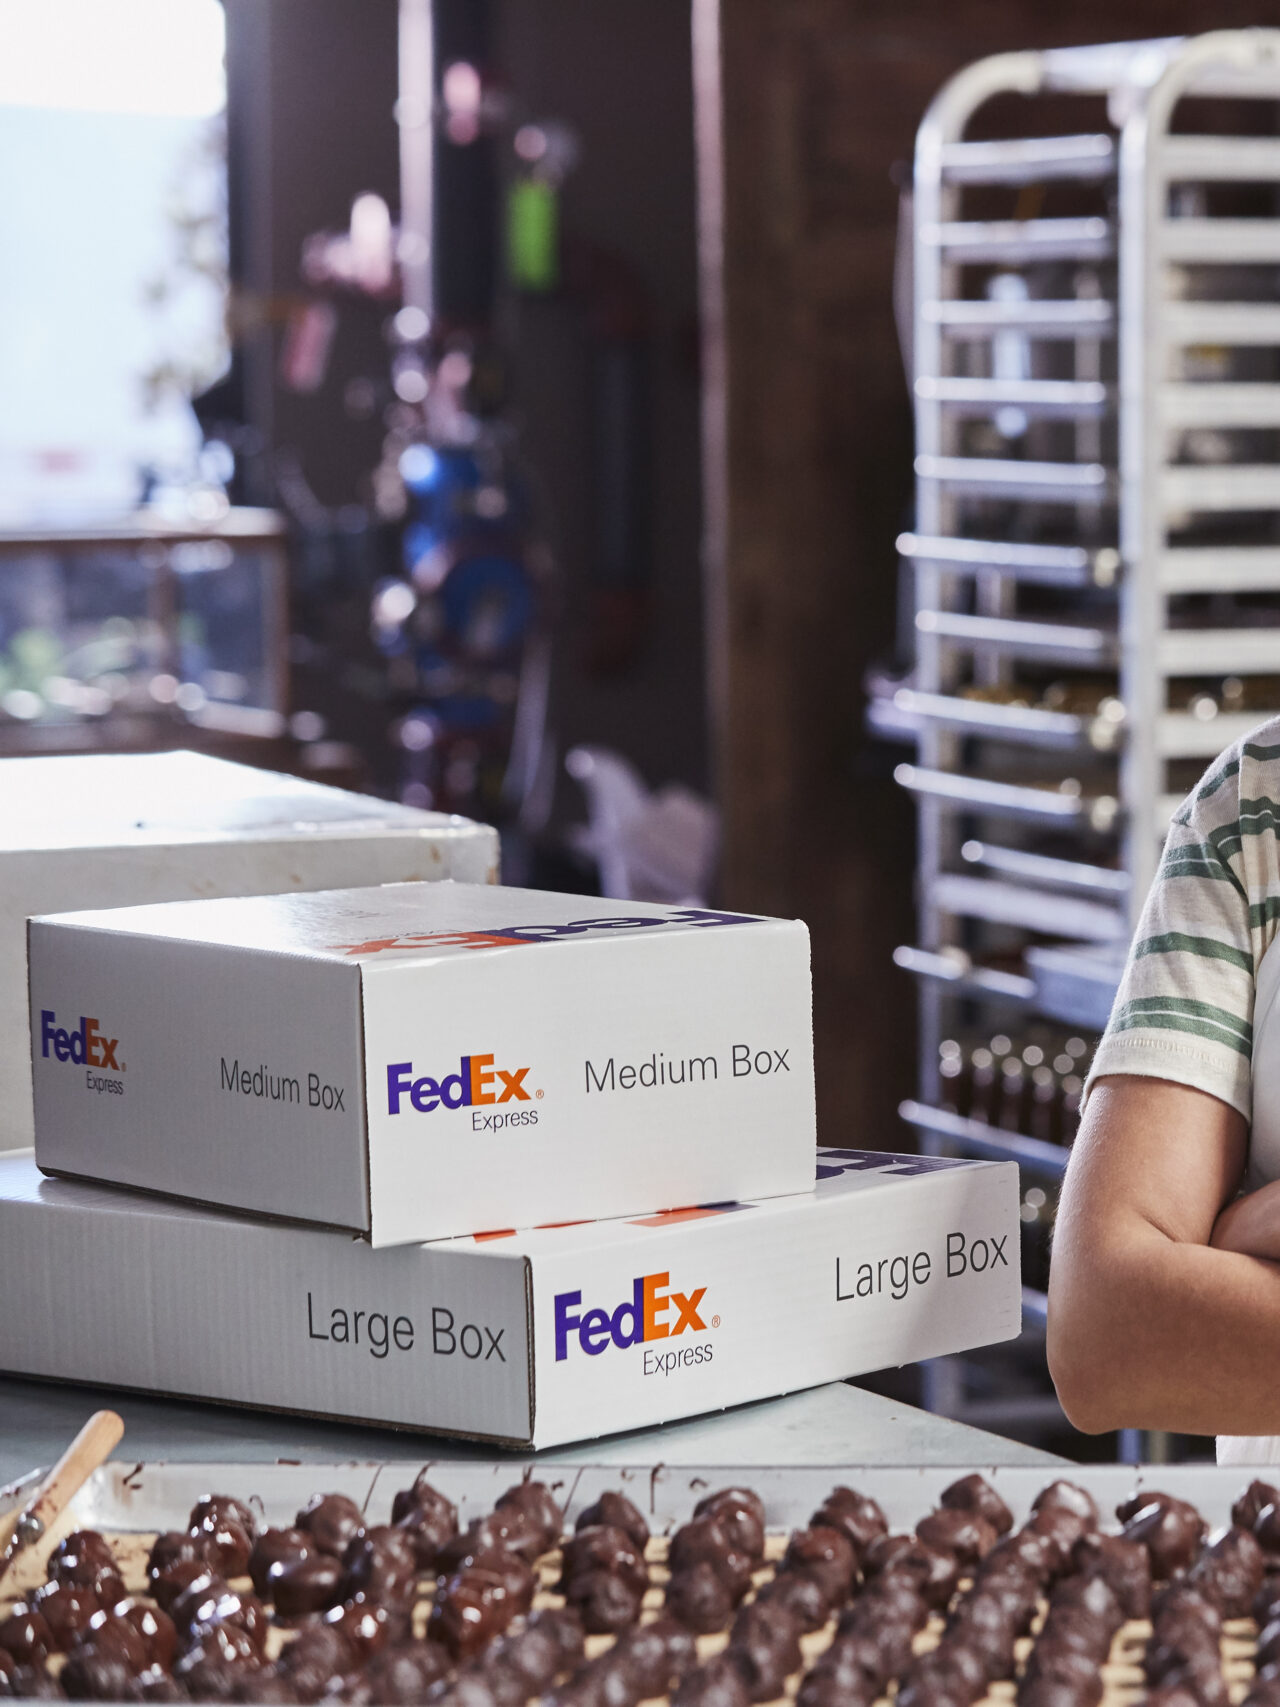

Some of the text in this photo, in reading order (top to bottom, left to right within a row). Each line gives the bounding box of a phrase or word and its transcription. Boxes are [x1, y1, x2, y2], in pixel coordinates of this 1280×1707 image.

[325, 910, 767, 956] FedEx
[41, 1010, 118, 1070] FedEx
[86, 1070, 124, 1096] Express
[221, 1058, 344, 1111] Medium Box
[387, 1053, 532, 1115] FedEx
[586, 1045, 790, 1093] Medium Box
[472, 1110, 538, 1133] Express
[837, 1232, 1008, 1302] Large Box
[308, 1293, 506, 1362] Large Box
[554, 1271, 708, 1362] FedEx
[643, 1342, 713, 1377] Express
